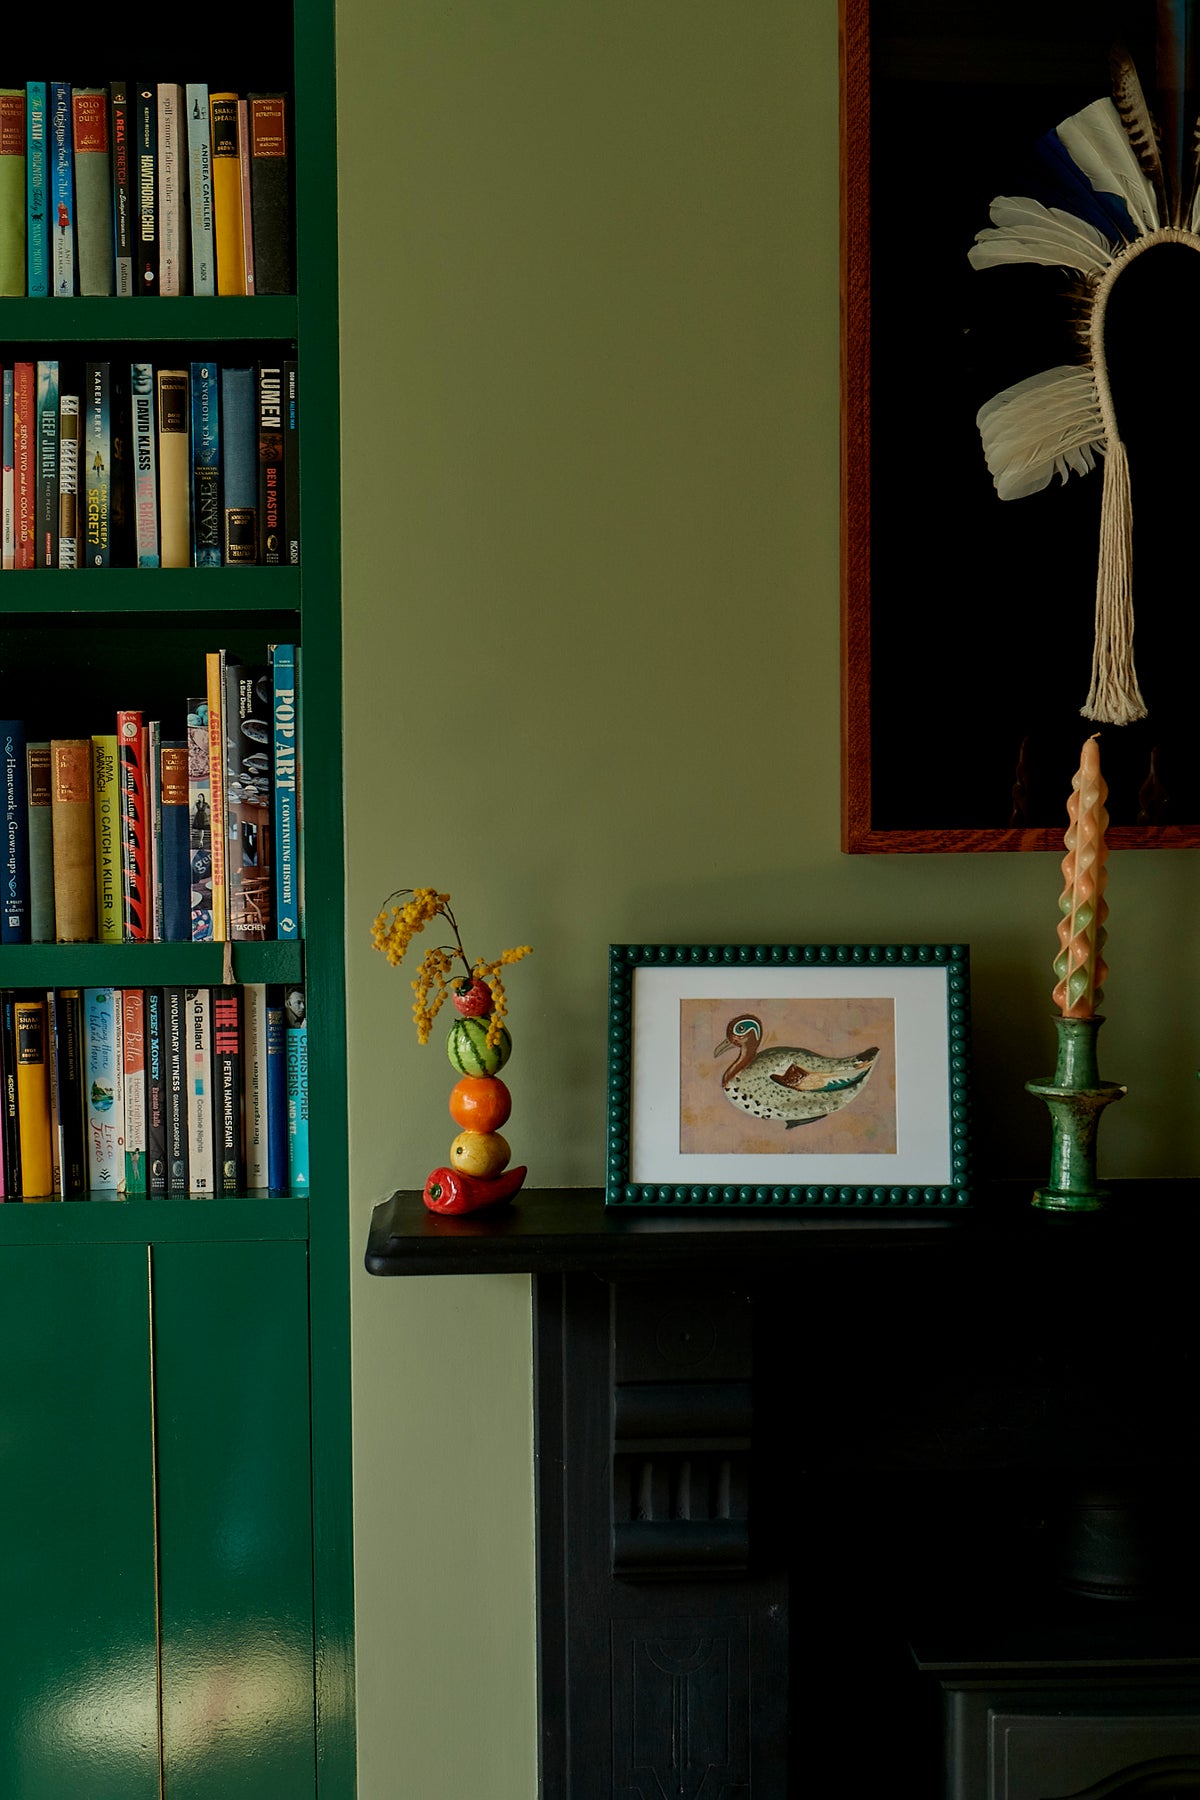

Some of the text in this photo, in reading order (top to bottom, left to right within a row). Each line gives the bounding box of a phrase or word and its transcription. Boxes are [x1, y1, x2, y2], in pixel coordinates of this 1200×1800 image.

[32, 96, 42, 111] The
[32, 111, 43, 140] DEATH
[78, 101, 99, 109] SOLO
[54, 88, 69, 197] the Christmas cookie club
[115, 119, 125, 143] REAL
[164, 98, 174, 203] spill simmer falter wither
[32, 152, 43, 187] DOWNTON
[117, 145, 126, 185] STRETCH
[141, 155, 155, 241] HAWTHORN&CHILD
[33, 223, 43, 275] MANDY MORTON
[120, 263, 129, 293] Autumn
[94, 371, 102, 439] KAREN PERRY
[201, 382, 210, 447] RICK RIORDAN
[260, 368, 281, 428] LUMEN
[20, 424, 29, 450] SEÑOR
[42, 410, 56, 479] DEEP JUNGLE
[137, 399, 151, 470] DAVID KLASS
[20, 472, 28, 487] and
[20, 488, 28, 496] the
[266, 468, 278, 528] BEN PASTOR
[88, 488, 99, 545] SECRET?
[138, 476, 155, 549] THE BRAVES
[200, 484, 213, 545] KANE
[210, 482, 218, 546] CHRONICLES
[290, 541, 299, 565] PICADOR
[275, 688, 296, 738] POP
[6, 758, 17, 811] Homework
[96, 746, 106, 793] KAVANAGH
[105, 756, 113, 783] EMMA
[276, 741, 296, 792] ART
[210, 711, 224, 886] SHOOT ANNUAL 1997
[7, 821, 18, 874] Grown-ups
[101, 800, 113, 909] TO CATCH A KILLER
[282, 804, 292, 861] CONTINUING
[129, 863, 137, 888] MOSLEY
[283, 863, 293, 904] HISTORY
[90, 1014, 101, 1041] Island
[99, 1011, 112, 1069] Coming Home
[126, 995, 142, 1063] Ciao Bella
[150, 995, 160, 1080] SWEET MONEY
[170, 994, 180, 1091] INVOLUNTARY WITNESS
[194, 1000, 204, 1050] JG Ballard
[215, 997, 239, 1055] THE LIE
[90, 1045, 101, 1073] House
[287, 1035, 298, 1097] HITCHENS
[299, 1035, 308, 1120] CHRISTOPHER
[133, 1078, 142, 1144] Helena Frith Powell
[152, 1087, 161, 1127] Ernesto Mallo
[223, 1060, 233, 1148] PETRA HAMMESFAHR
[253, 1094, 261, 1126] regardait
[90, 1118, 105, 1163] James
[104, 1124, 116, 1159] Erica
[196, 1130, 205, 1153] Nights
